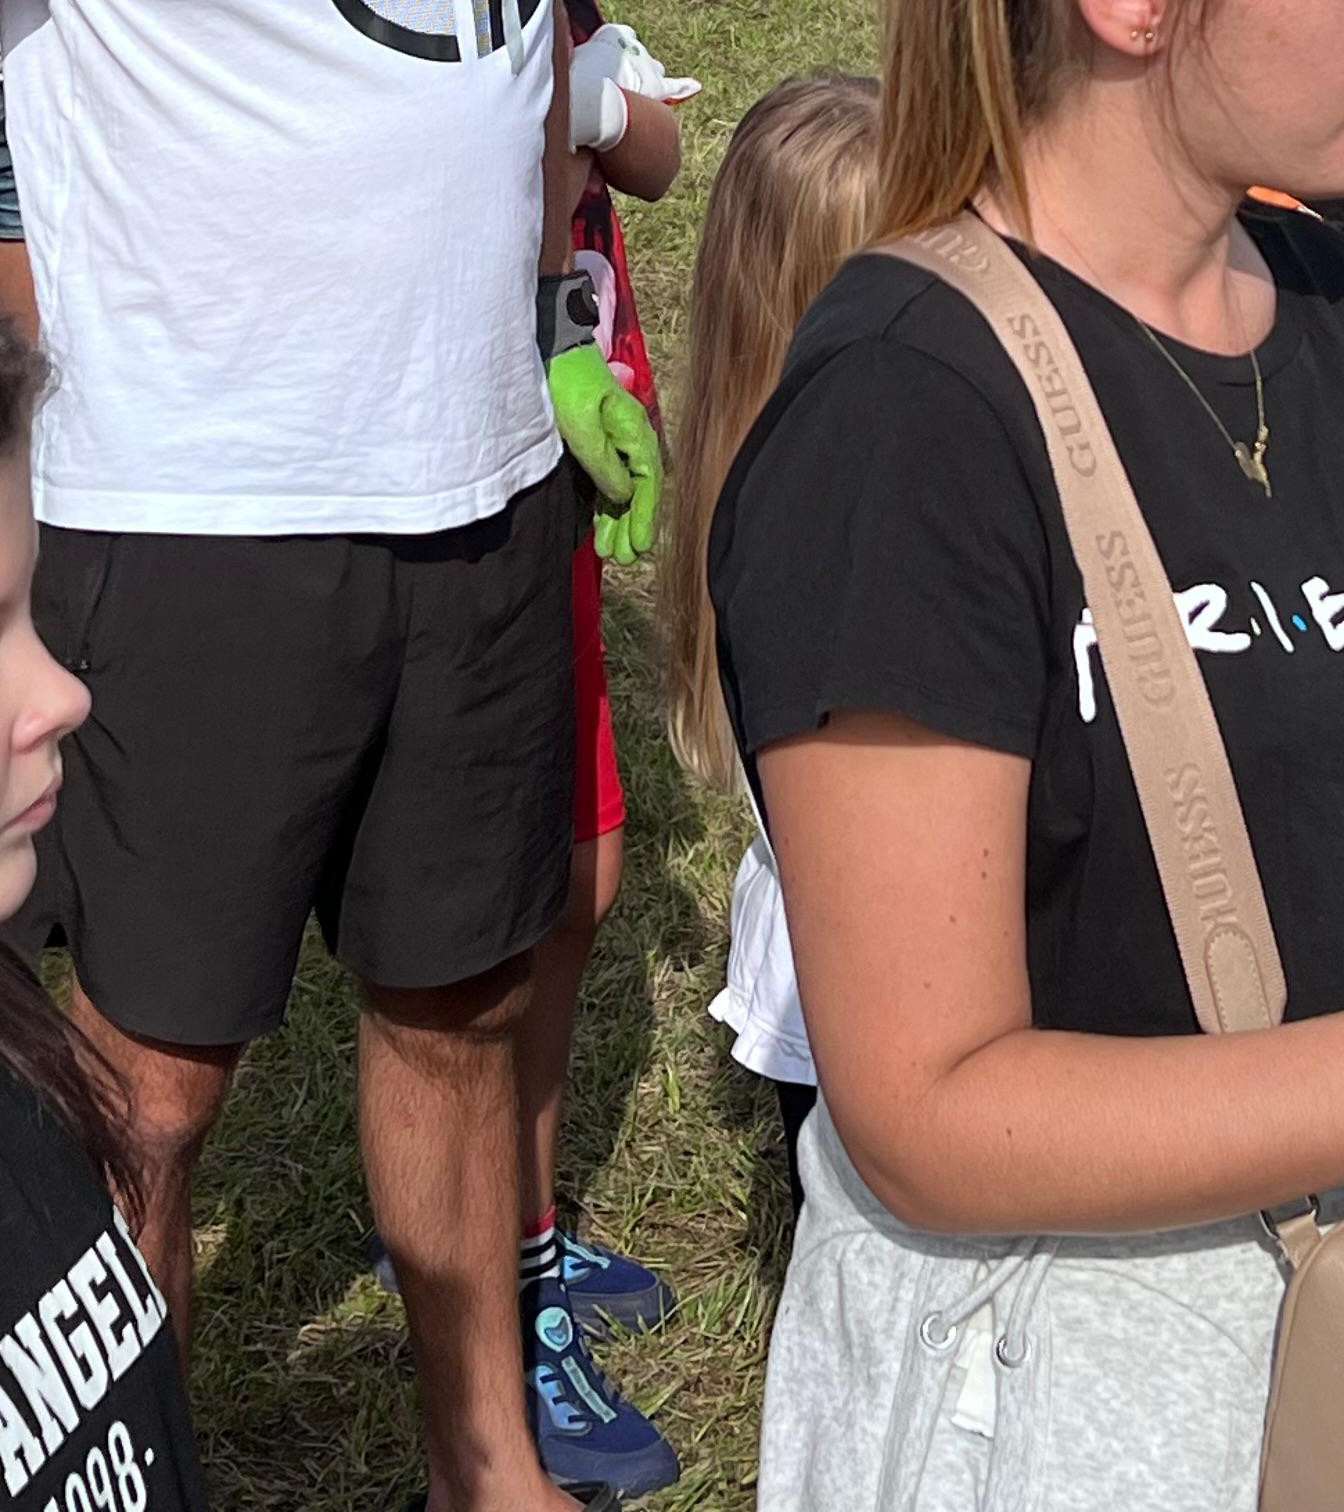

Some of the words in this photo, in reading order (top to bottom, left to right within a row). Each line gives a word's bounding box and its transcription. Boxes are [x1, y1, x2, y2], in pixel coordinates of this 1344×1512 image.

[1006, 311, 1099, 479] GUESS
[1095, 529, 1177, 709] GUESS
[1163, 761, 1240, 929] UESS
